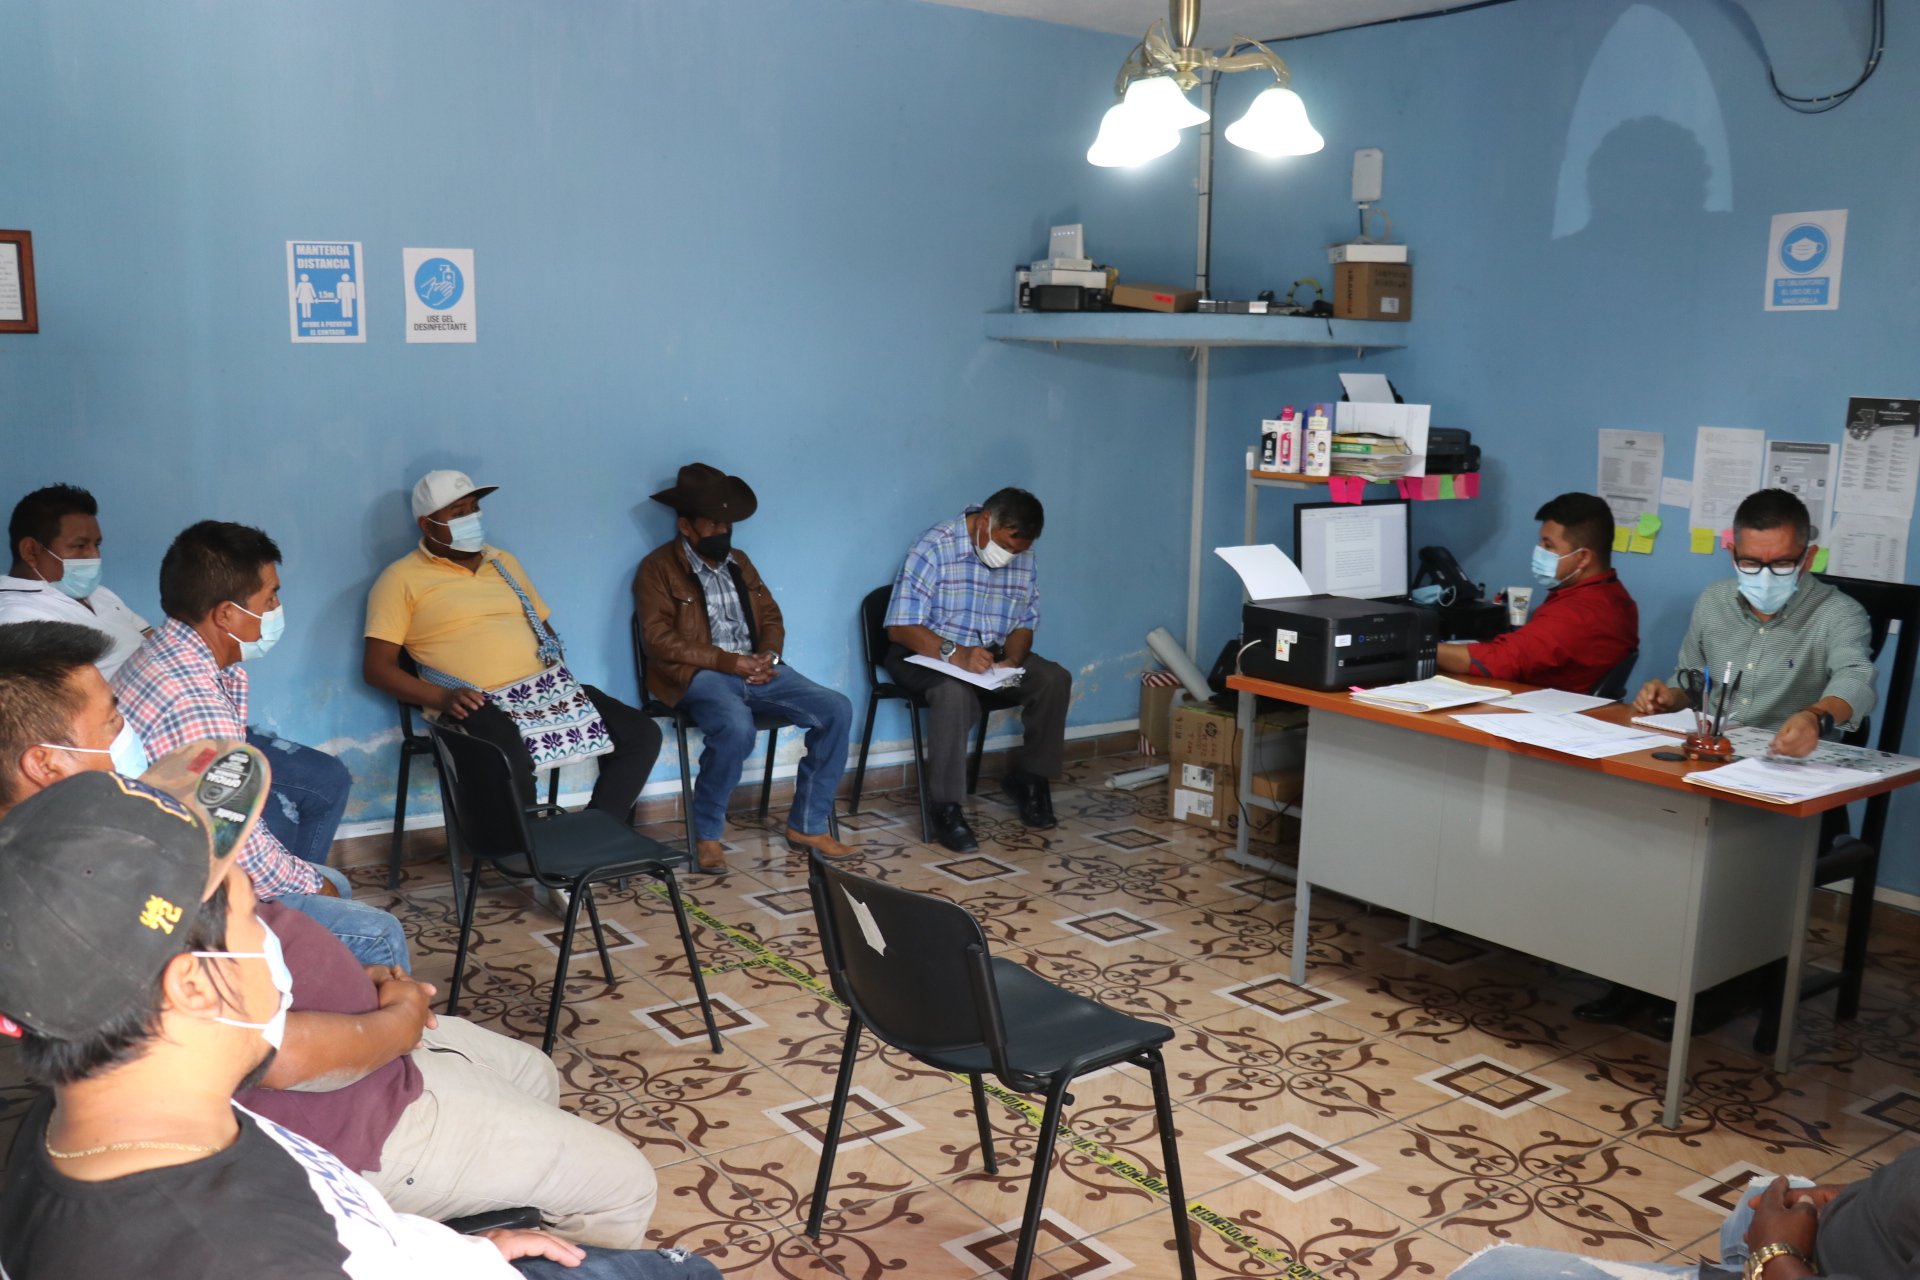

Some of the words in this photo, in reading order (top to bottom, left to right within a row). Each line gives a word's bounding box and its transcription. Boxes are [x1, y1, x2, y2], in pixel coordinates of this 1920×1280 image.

[296, 244, 350, 256] MANTENGA
[297, 258, 351, 269] DISTANCIA
[441, 315, 454, 323] GEL
[414, 323, 468, 331] DESINFECTANTE
[206, 772, 242, 788] OFFICIAL
